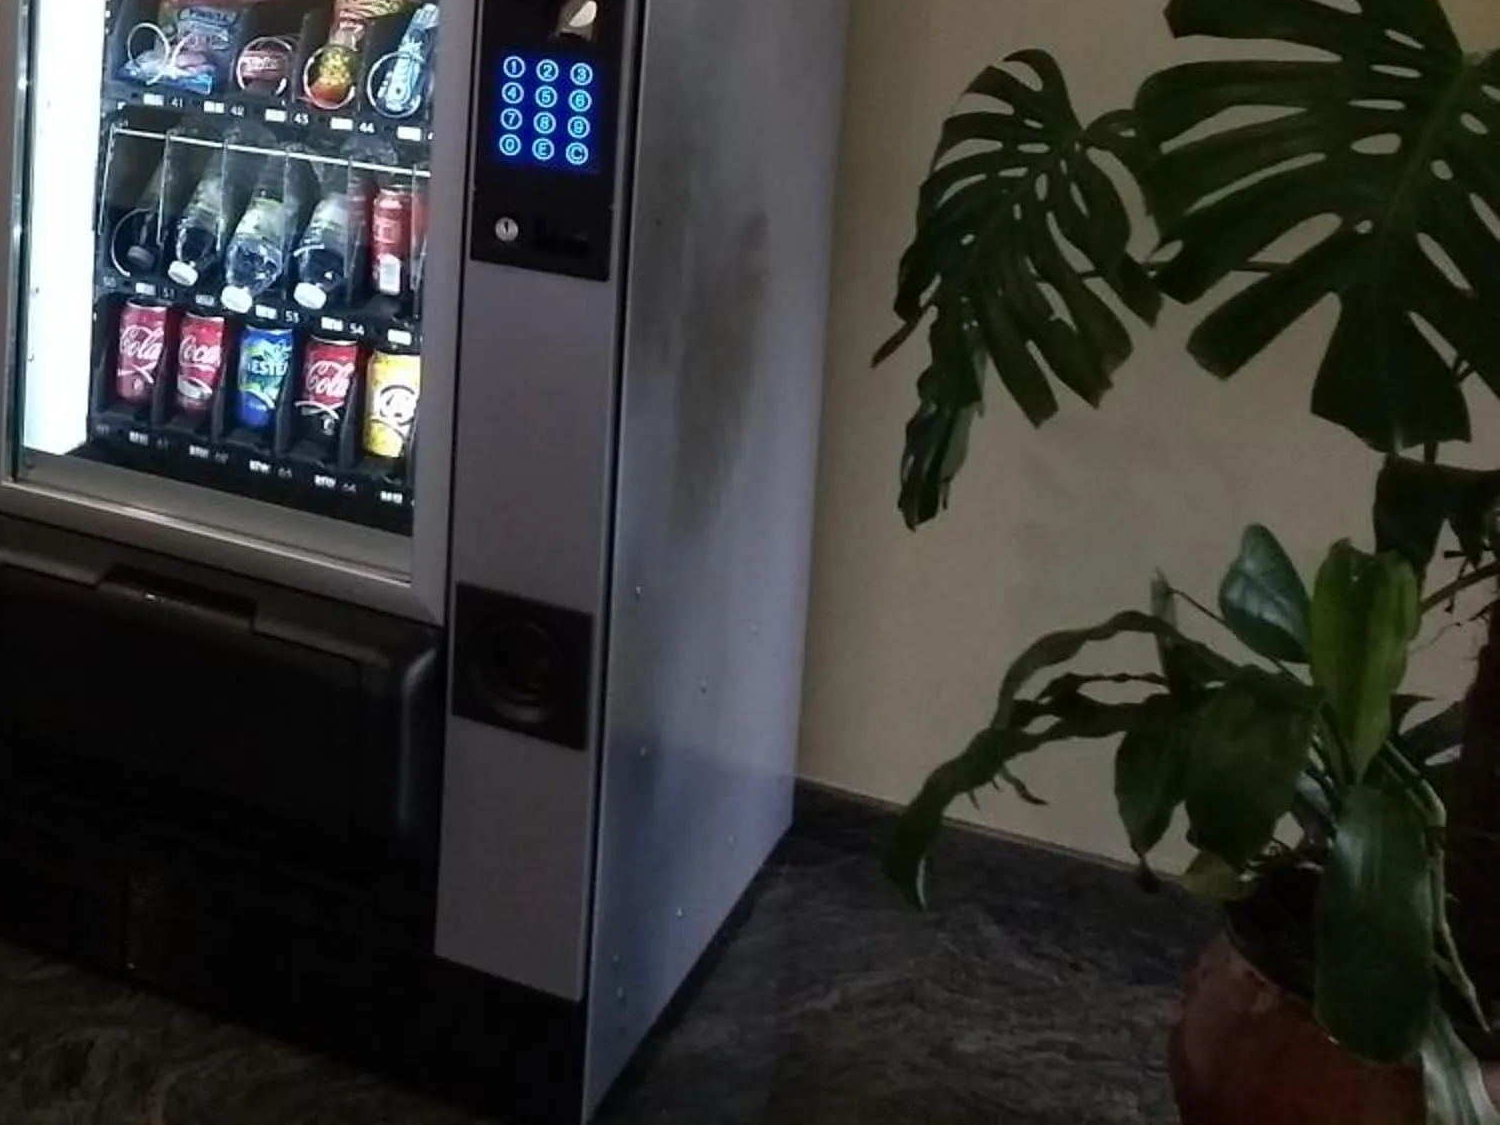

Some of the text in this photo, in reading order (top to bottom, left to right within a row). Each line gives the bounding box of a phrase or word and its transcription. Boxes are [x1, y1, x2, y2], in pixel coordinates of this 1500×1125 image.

[511, 60, 587, 81] 1 2 3
[171, 96, 183, 108] 41
[507, 86, 585, 108] 4 5 6
[507, 112, 584, 134] 7 8 9
[505, 138, 583, 160] 0 E C
